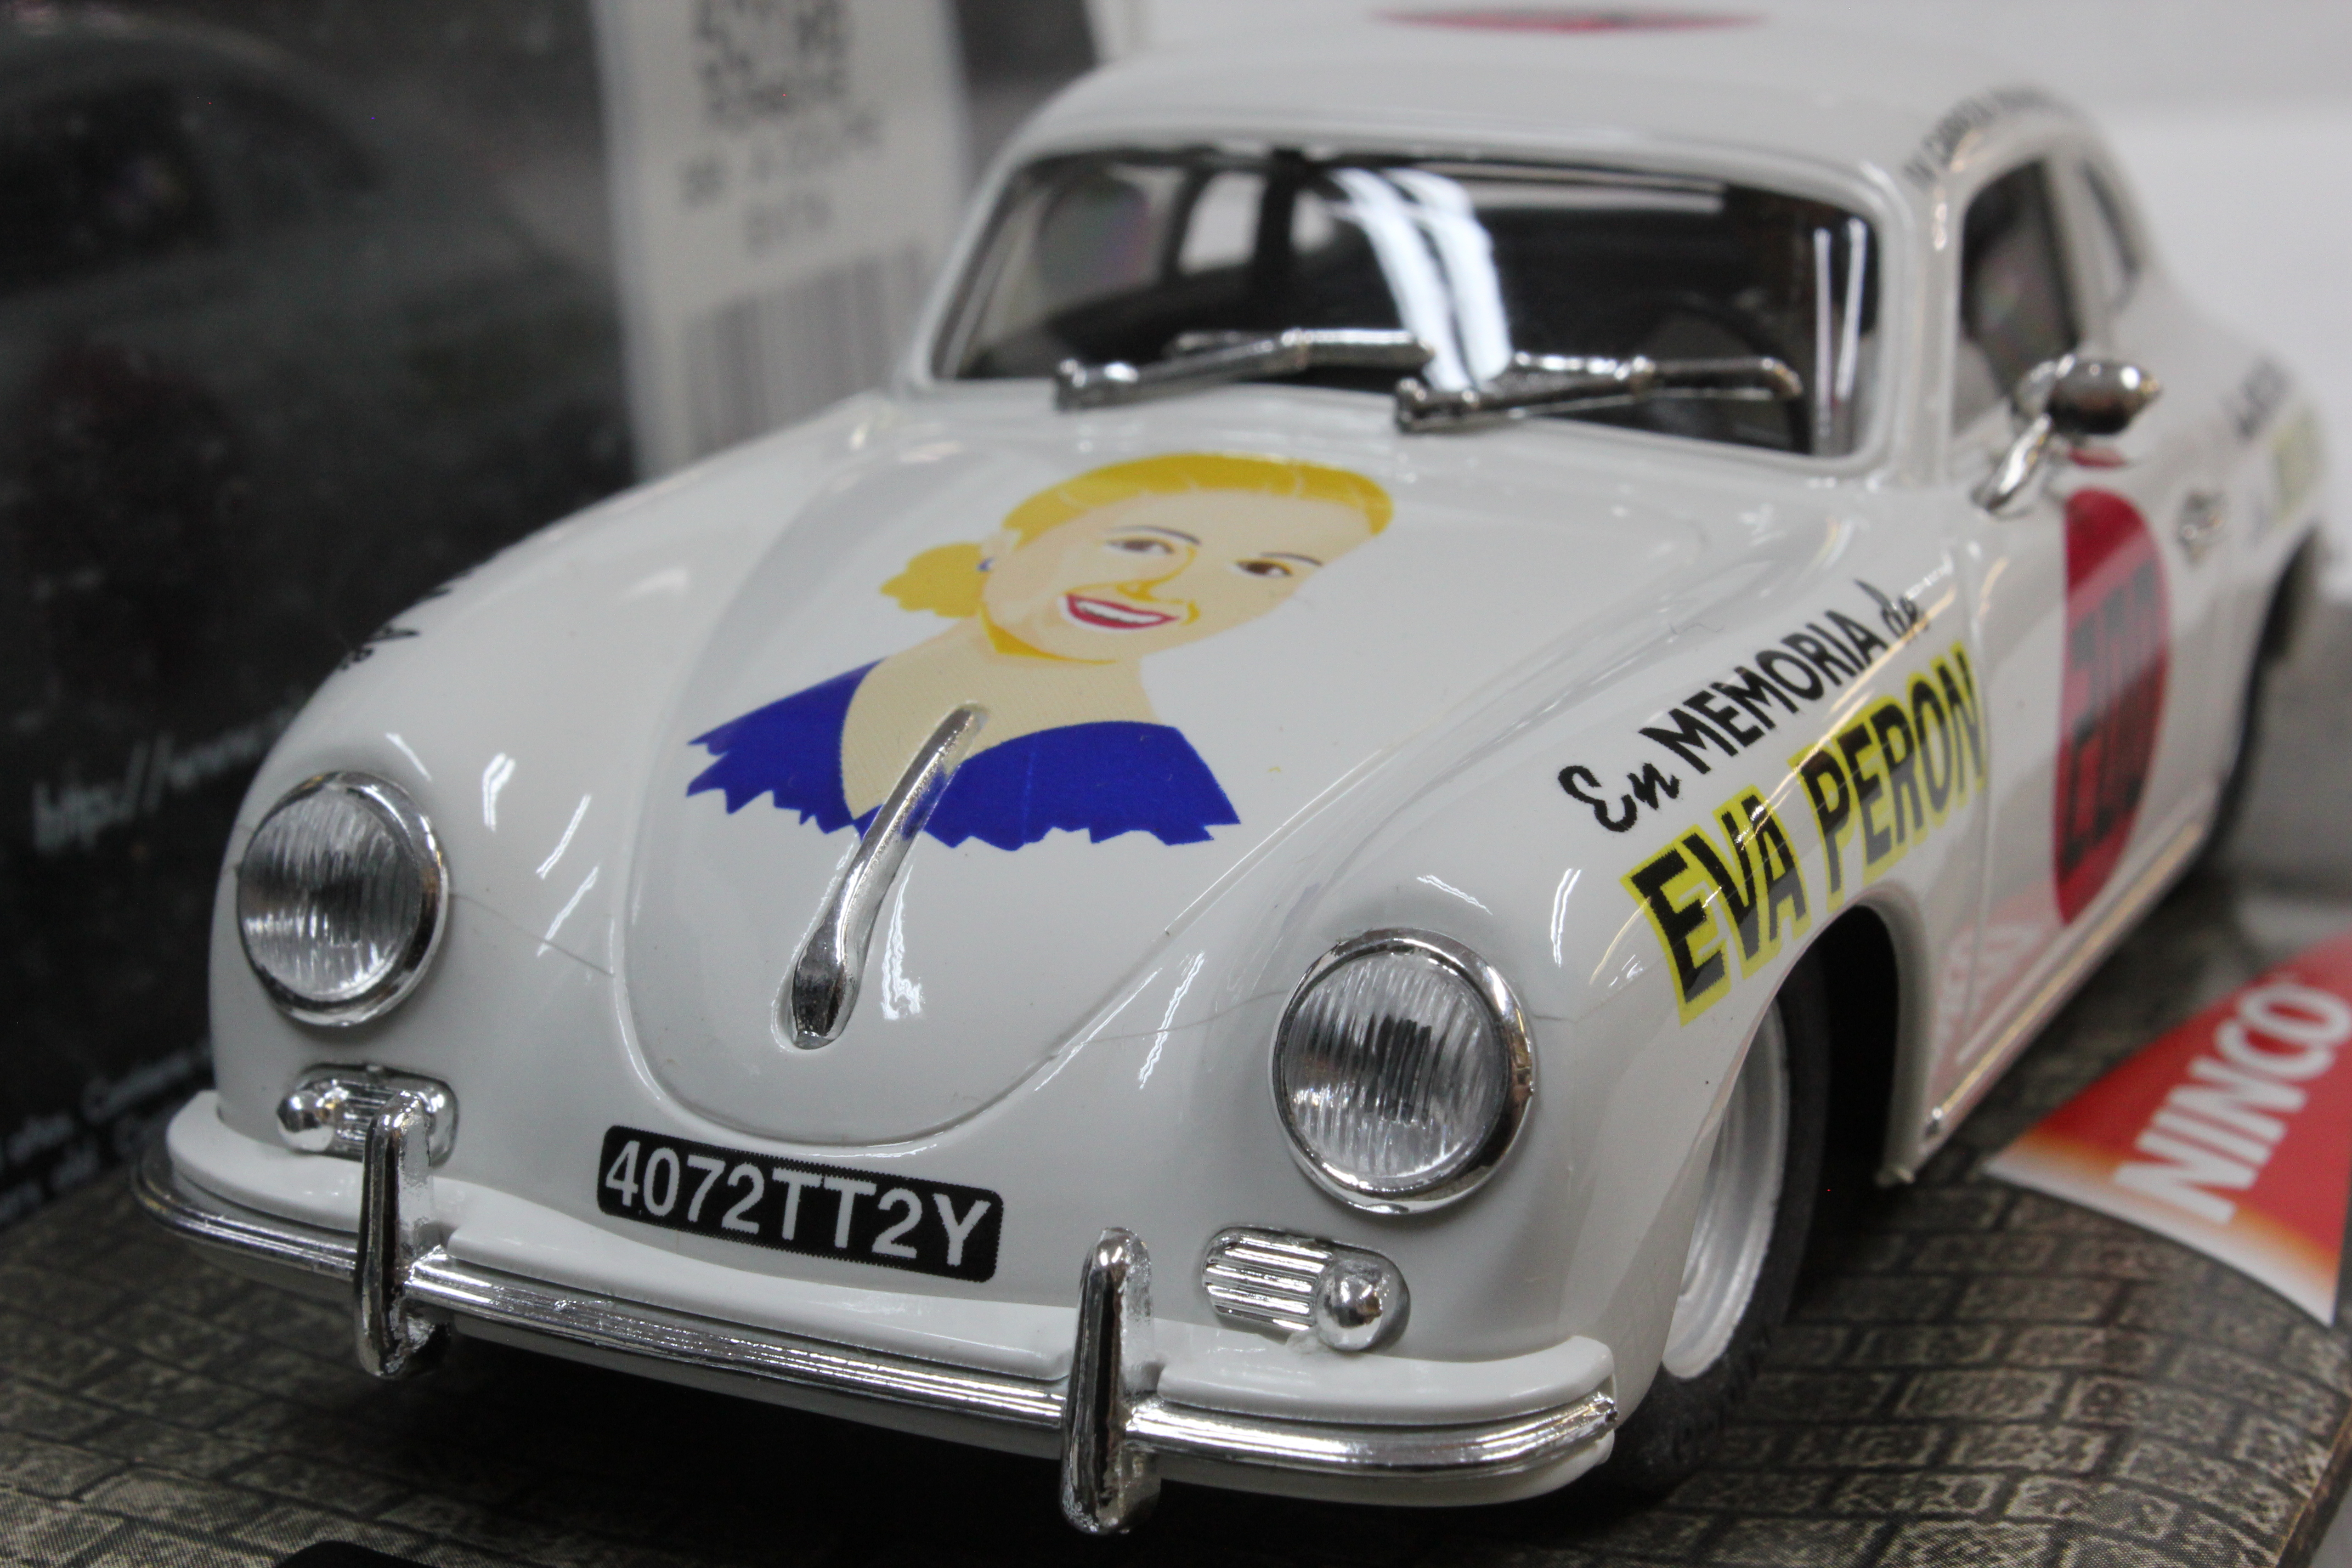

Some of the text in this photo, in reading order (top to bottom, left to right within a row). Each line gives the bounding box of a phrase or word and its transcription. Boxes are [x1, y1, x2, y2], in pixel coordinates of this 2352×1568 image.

[1557, 578, 1930, 833] En MEMORIA de
[1629, 791, 1808, 1005] EVA
[1793, 648, 1986, 896] PERON
[605, 1138, 992, 1268] 4072TT2Y
[2113, 975, 2352, 1226] NINCO
